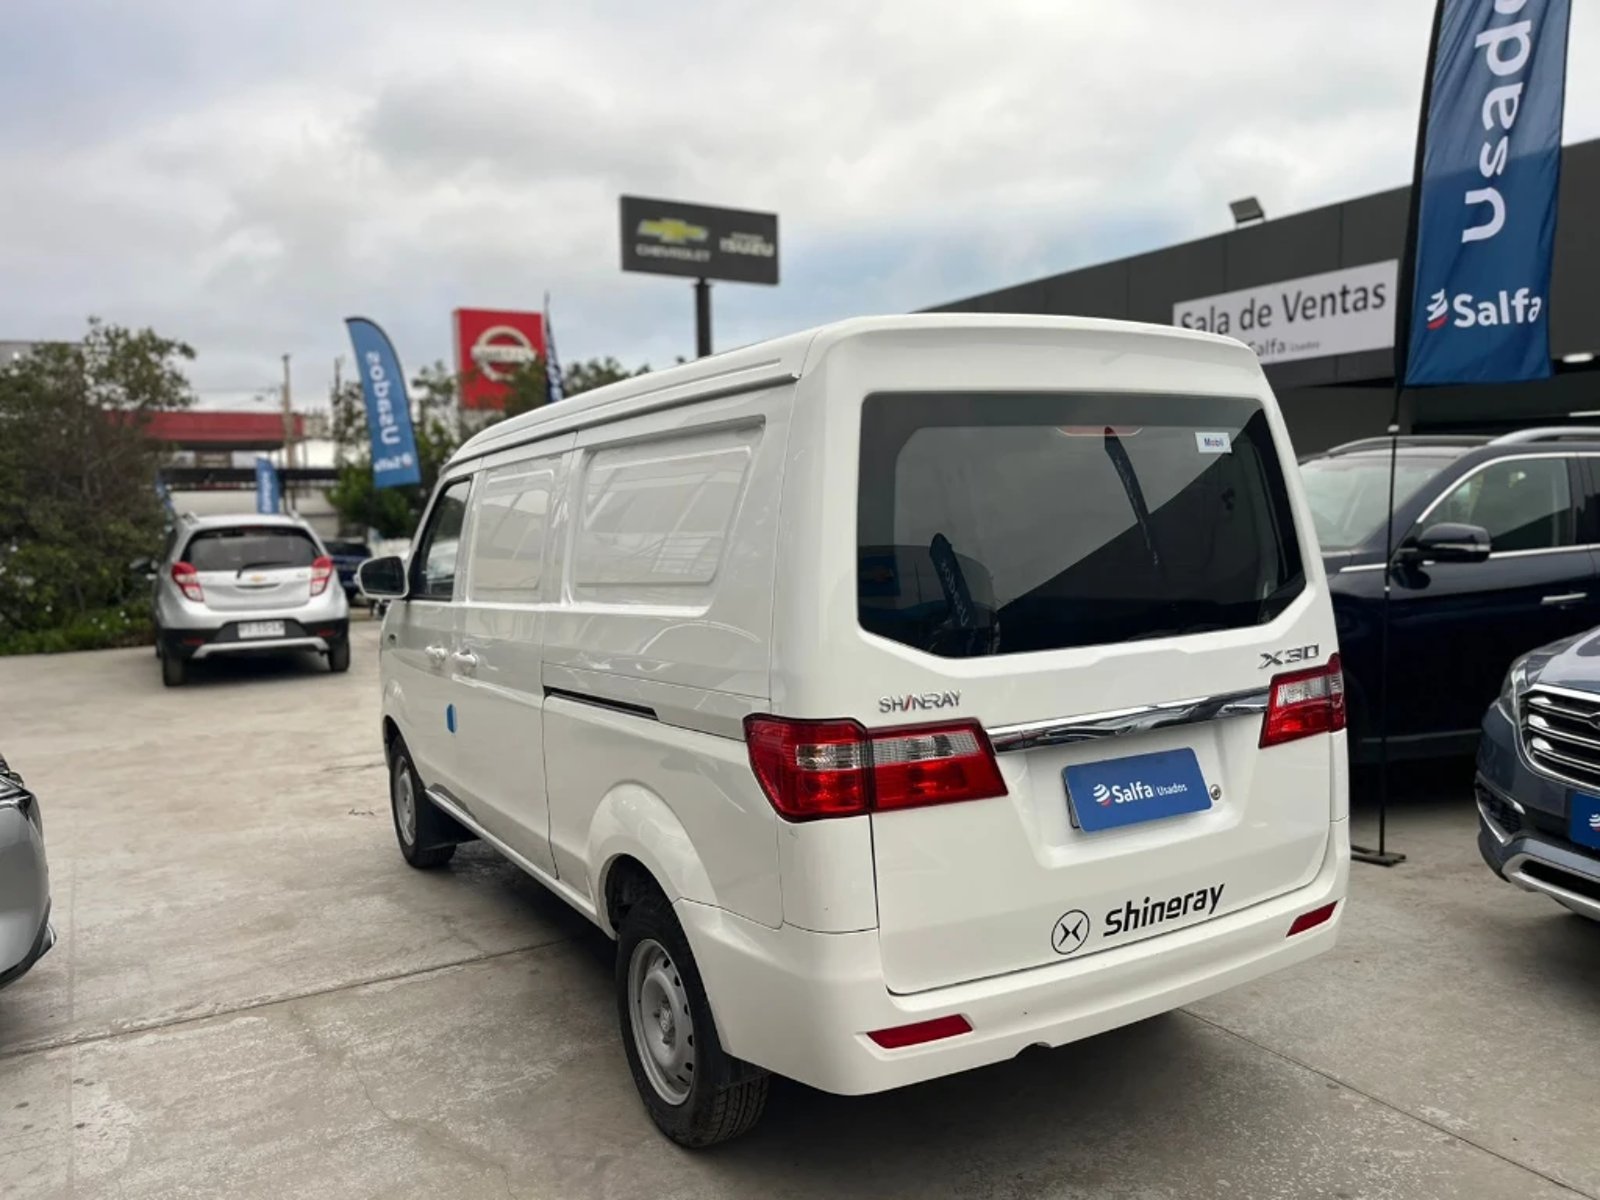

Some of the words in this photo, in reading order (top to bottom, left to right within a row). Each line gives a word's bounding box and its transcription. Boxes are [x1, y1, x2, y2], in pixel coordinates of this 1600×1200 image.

[1181, 305, 1230, 336] Sala
[1239, 297, 1272, 332] de
[1281, 282, 1386, 324] Ventas
[1453, 287, 1542, 328] Salfa
[1257, 643, 1320, 670] X30
[879, 690, 961, 714] SHINERAY
[1111, 781, 1154, 804] Salfa
[1156, 782, 1188, 797] Usados
